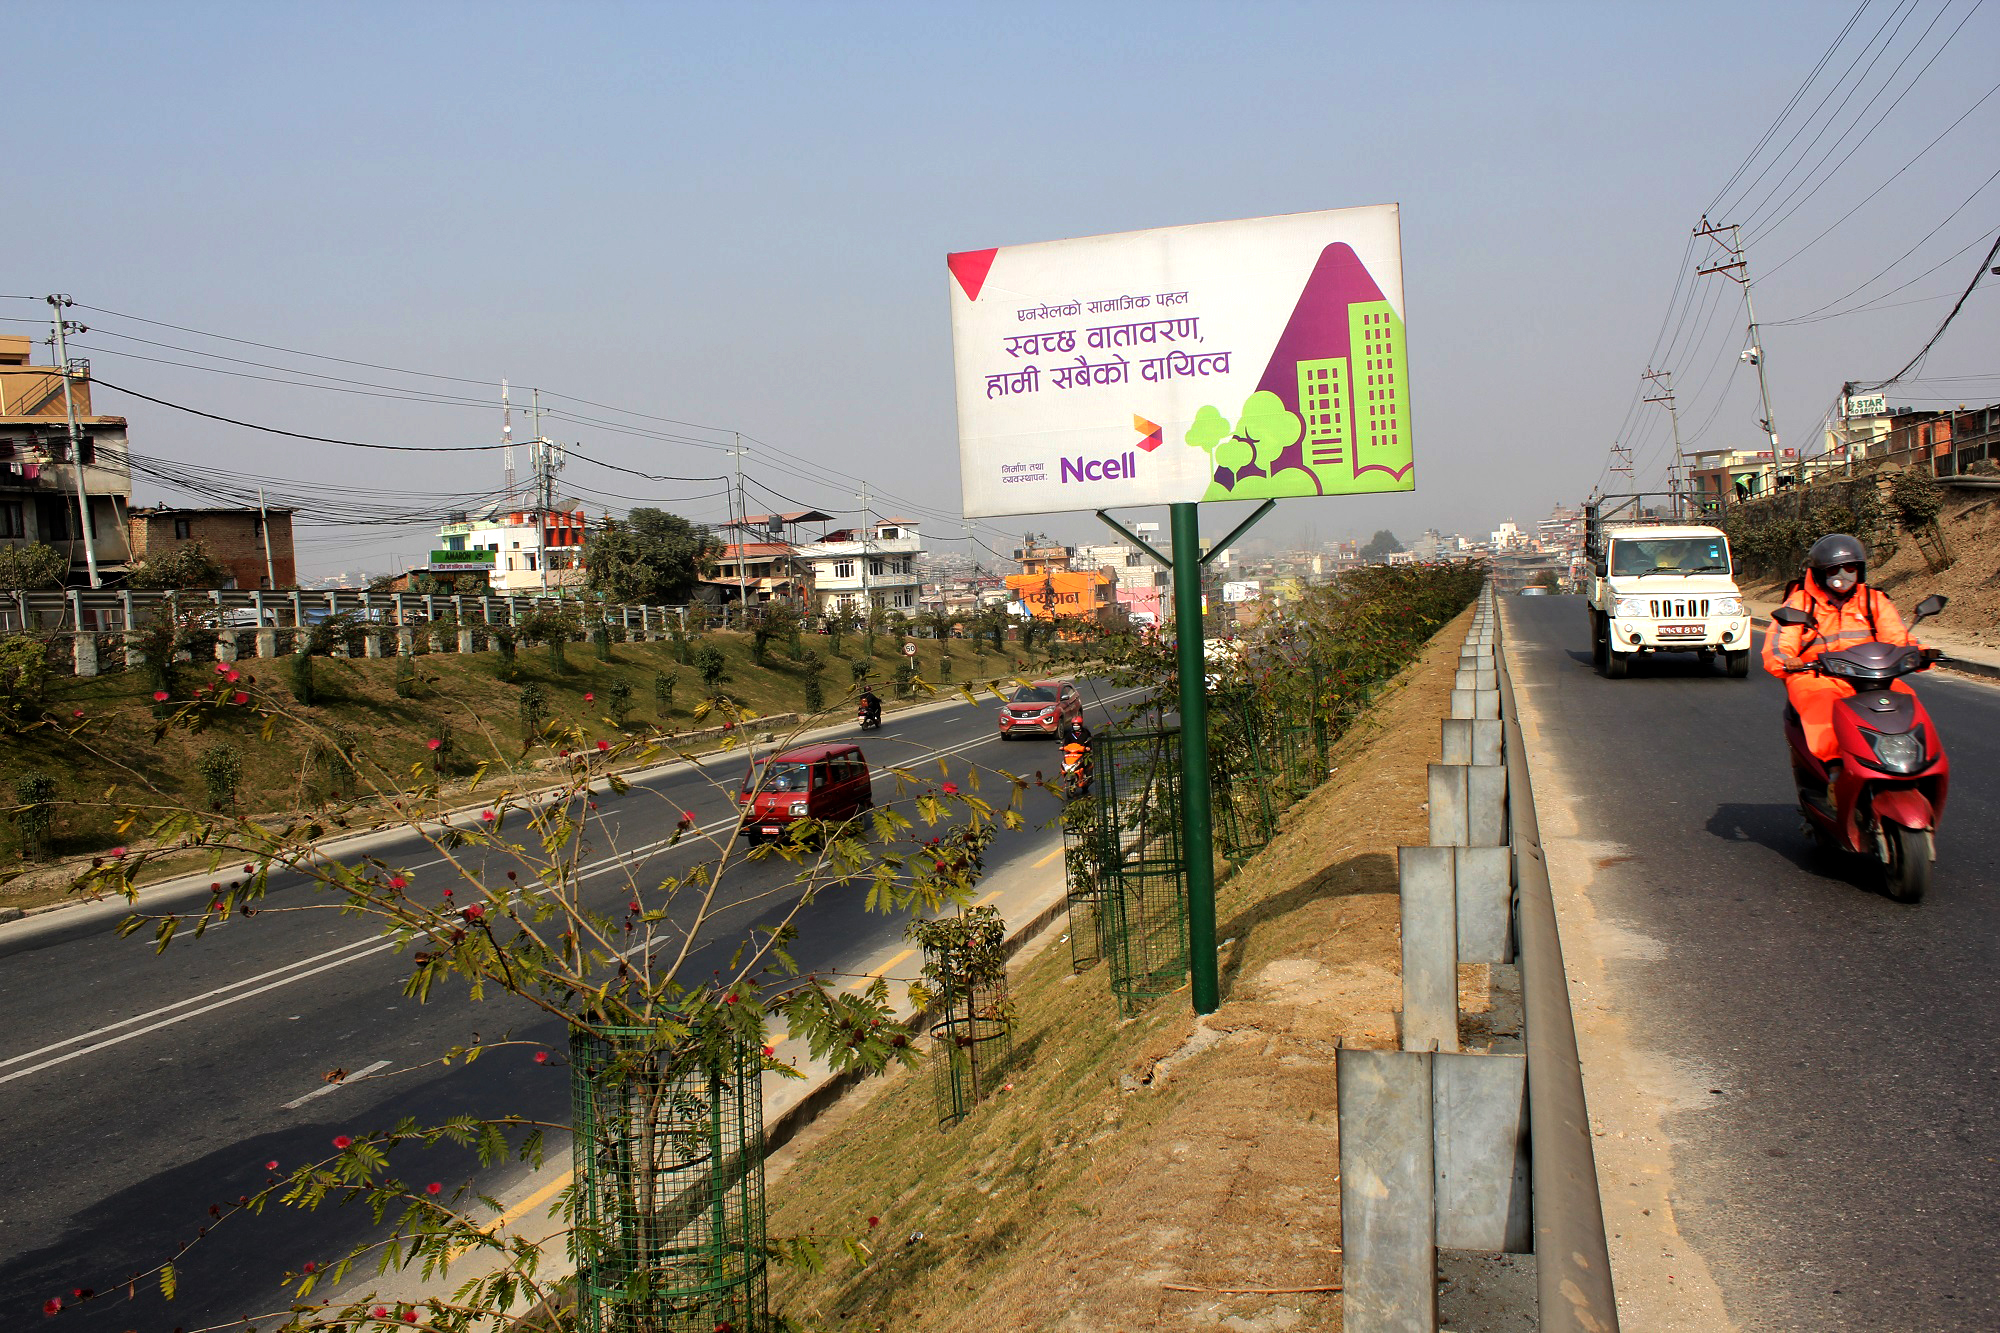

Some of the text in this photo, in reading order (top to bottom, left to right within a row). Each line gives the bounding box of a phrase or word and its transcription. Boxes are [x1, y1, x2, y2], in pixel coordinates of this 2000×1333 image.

[1017, 291, 1189, 322] एनसेलको सामाजिक पहल
[1003, 317, 1204, 358] स्वच्छ वातावरण,
[985, 350, 1232, 400] हामी सबैको दायित्व
[1851, 407, 1883, 415] HOSPITAL
[1856, 398, 1883, 409] STAR
[1001, 462, 1044, 474] निर्माण तथा
[1060, 451, 1135, 484] Ncell
[445, 551, 472, 561] AMARON
